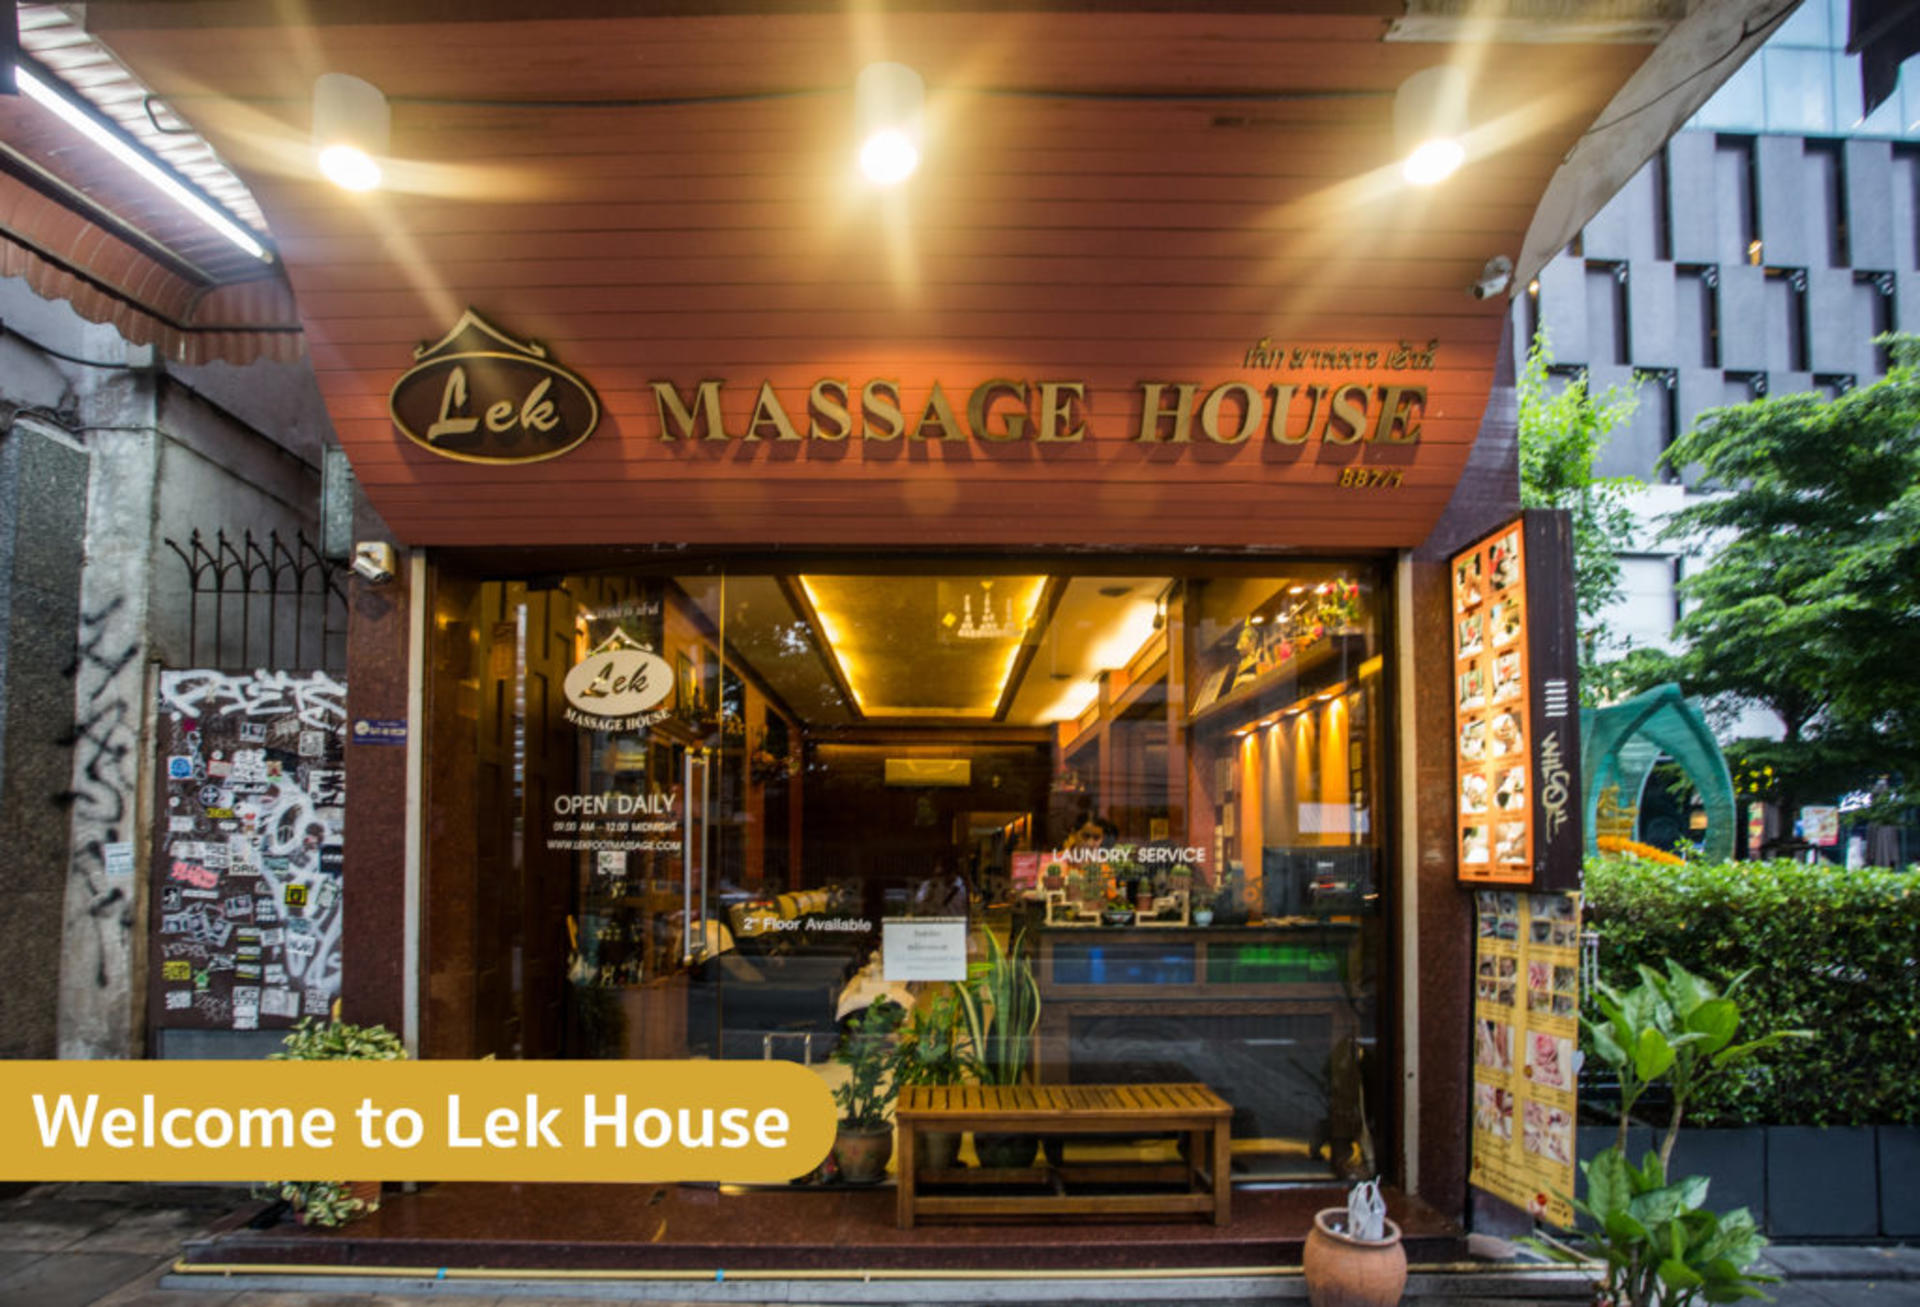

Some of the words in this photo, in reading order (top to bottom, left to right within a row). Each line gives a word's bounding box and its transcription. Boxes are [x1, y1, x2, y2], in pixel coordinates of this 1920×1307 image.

[428, 366, 559, 440] Lek
[648, 377, 1086, 444] MASSAGE
[1137, 381, 1428, 446] HOUSE
[579, 661, 650, 698] Lek
[563, 707, 624, 731] MASSAGE
[625, 708, 672, 731] HOUSE
[554, 795, 608, 815] OPEN
[617, 794, 677, 815] DAILY
[579, 821, 595, 832] AM
[1052, 848, 1130, 863] LAUNDRY
[1138, 848, 1206, 863] SERVICE
[763, 917, 802, 931] Floor
[805, 917, 872, 932] Available
